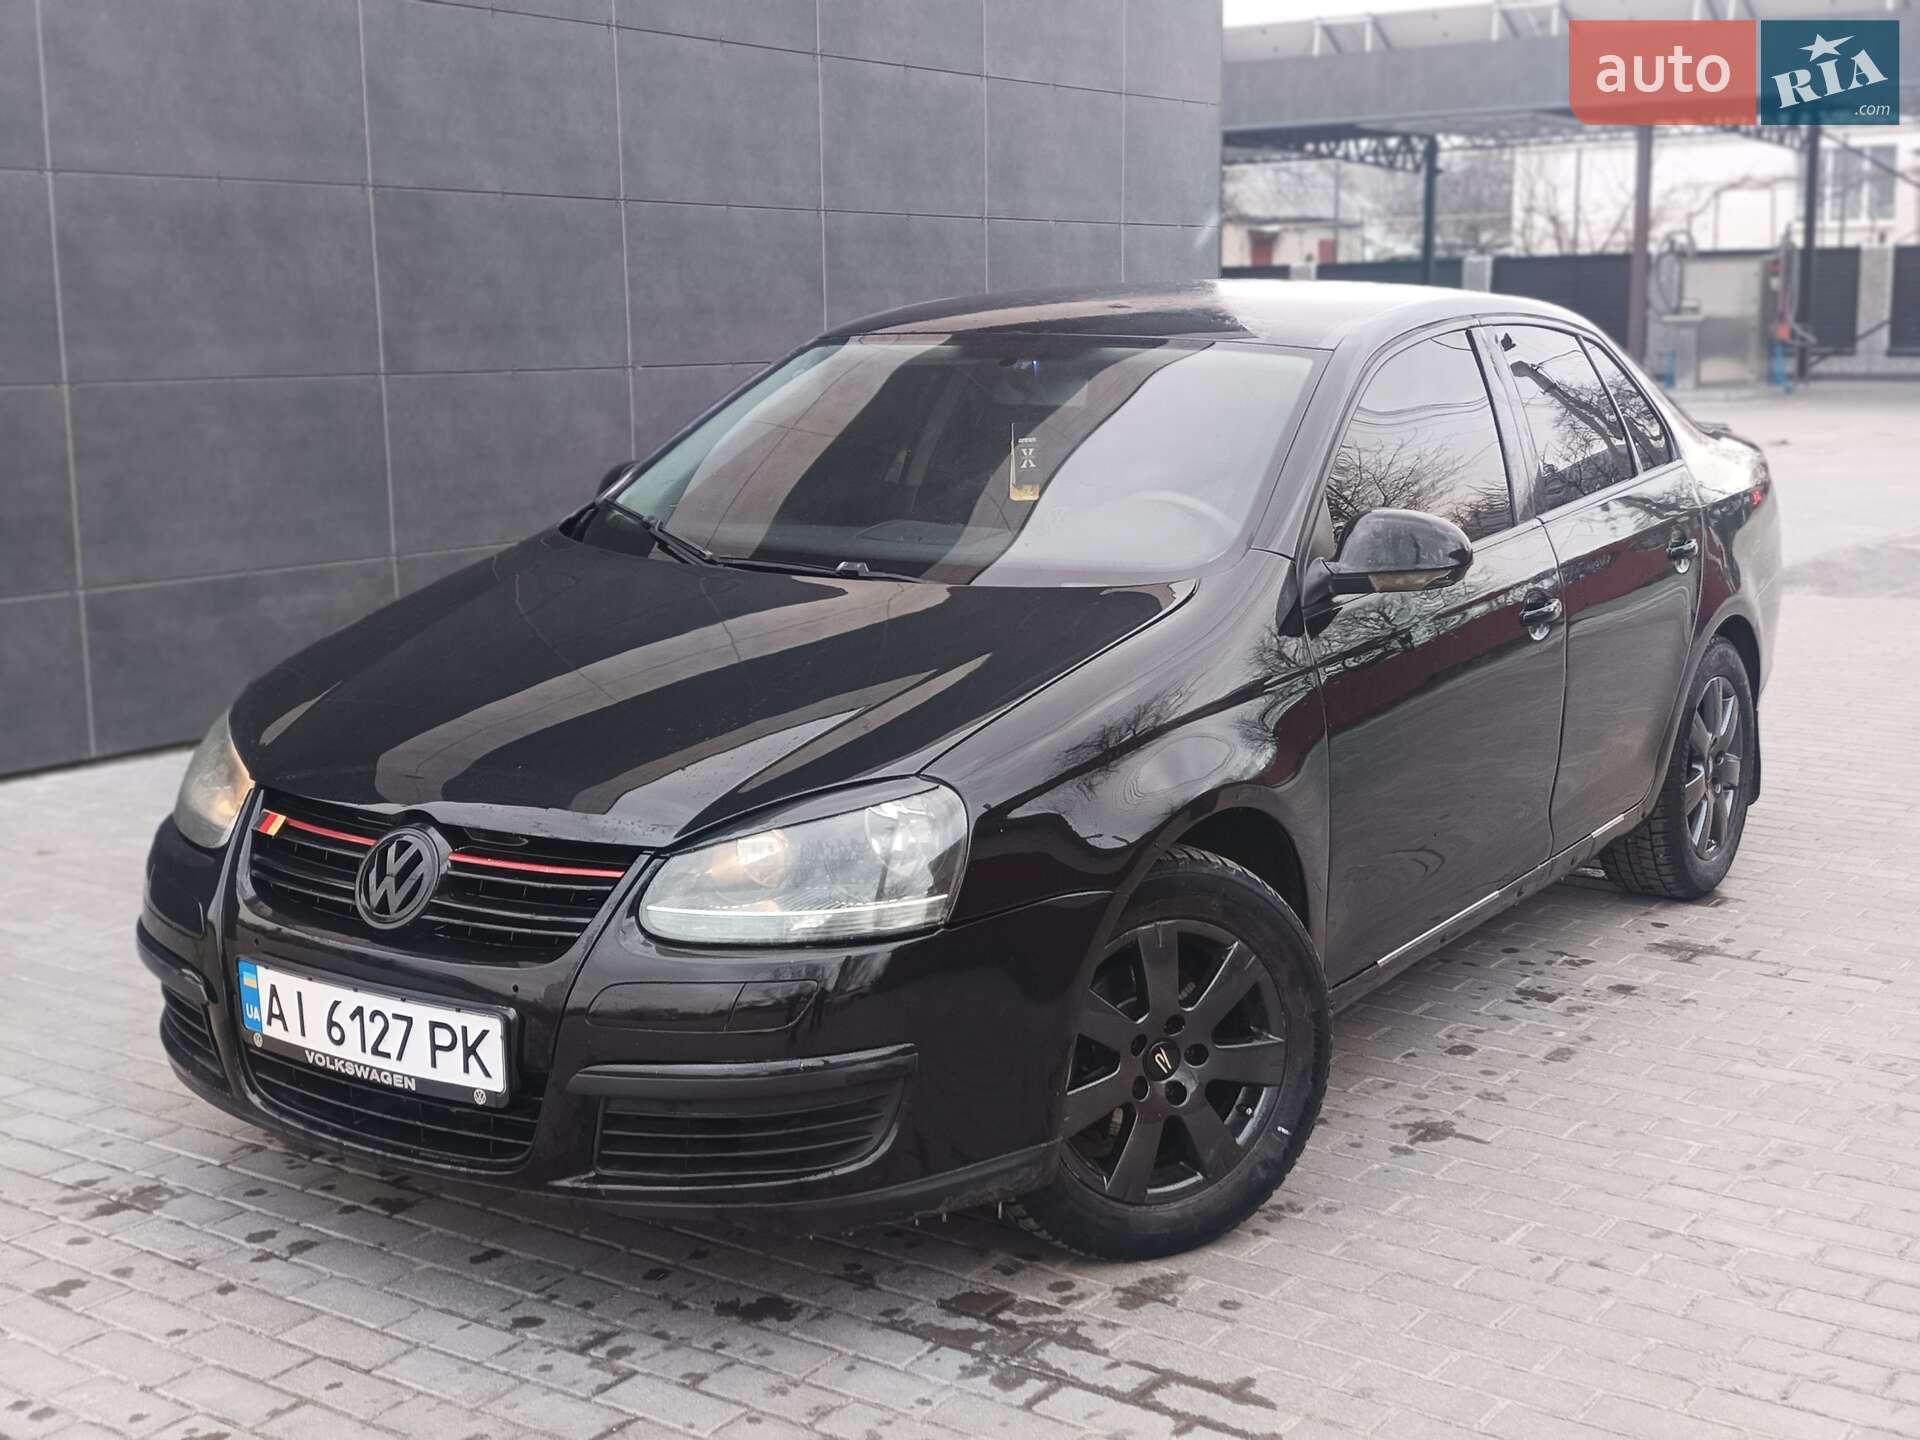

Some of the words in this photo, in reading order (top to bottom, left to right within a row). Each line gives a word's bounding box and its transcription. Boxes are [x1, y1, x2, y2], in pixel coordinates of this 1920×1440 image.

[245, 1003, 261, 1023] UA
[266, 983, 306, 1038] AI
[326, 999, 414, 1062] 6127
[428, 1020, 492, 1079] PK
[304, 1049, 416, 1092] VOLKSWAGEN
